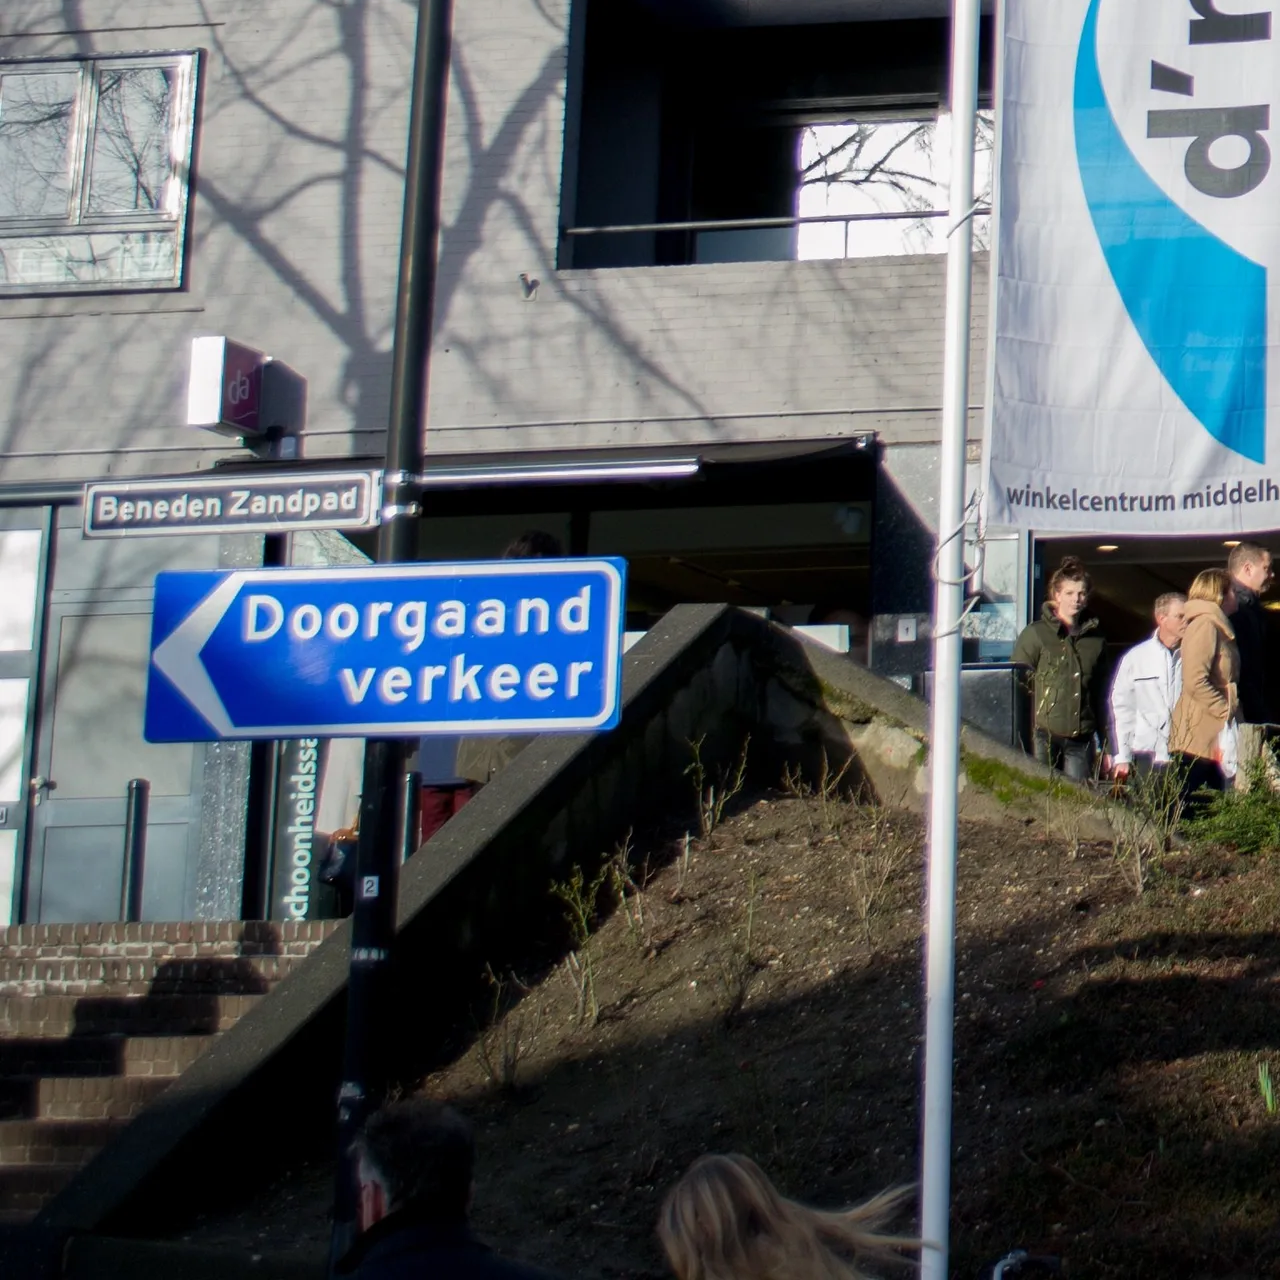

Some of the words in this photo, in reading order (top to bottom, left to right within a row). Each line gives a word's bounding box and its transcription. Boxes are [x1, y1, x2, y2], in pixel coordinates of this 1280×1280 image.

[228, 369, 250, 405] da
[98, 494, 222, 521] Beneden
[229, 486, 359, 519] Zandpad
[1006, 484, 1177, 513] winkelcentrum
[243, 584, 592, 654] Doorgaand
[340, 653, 594, 706] verkeer
[284, 737, 319, 923] choonheidss
[364, 879, 375, 894] 2
